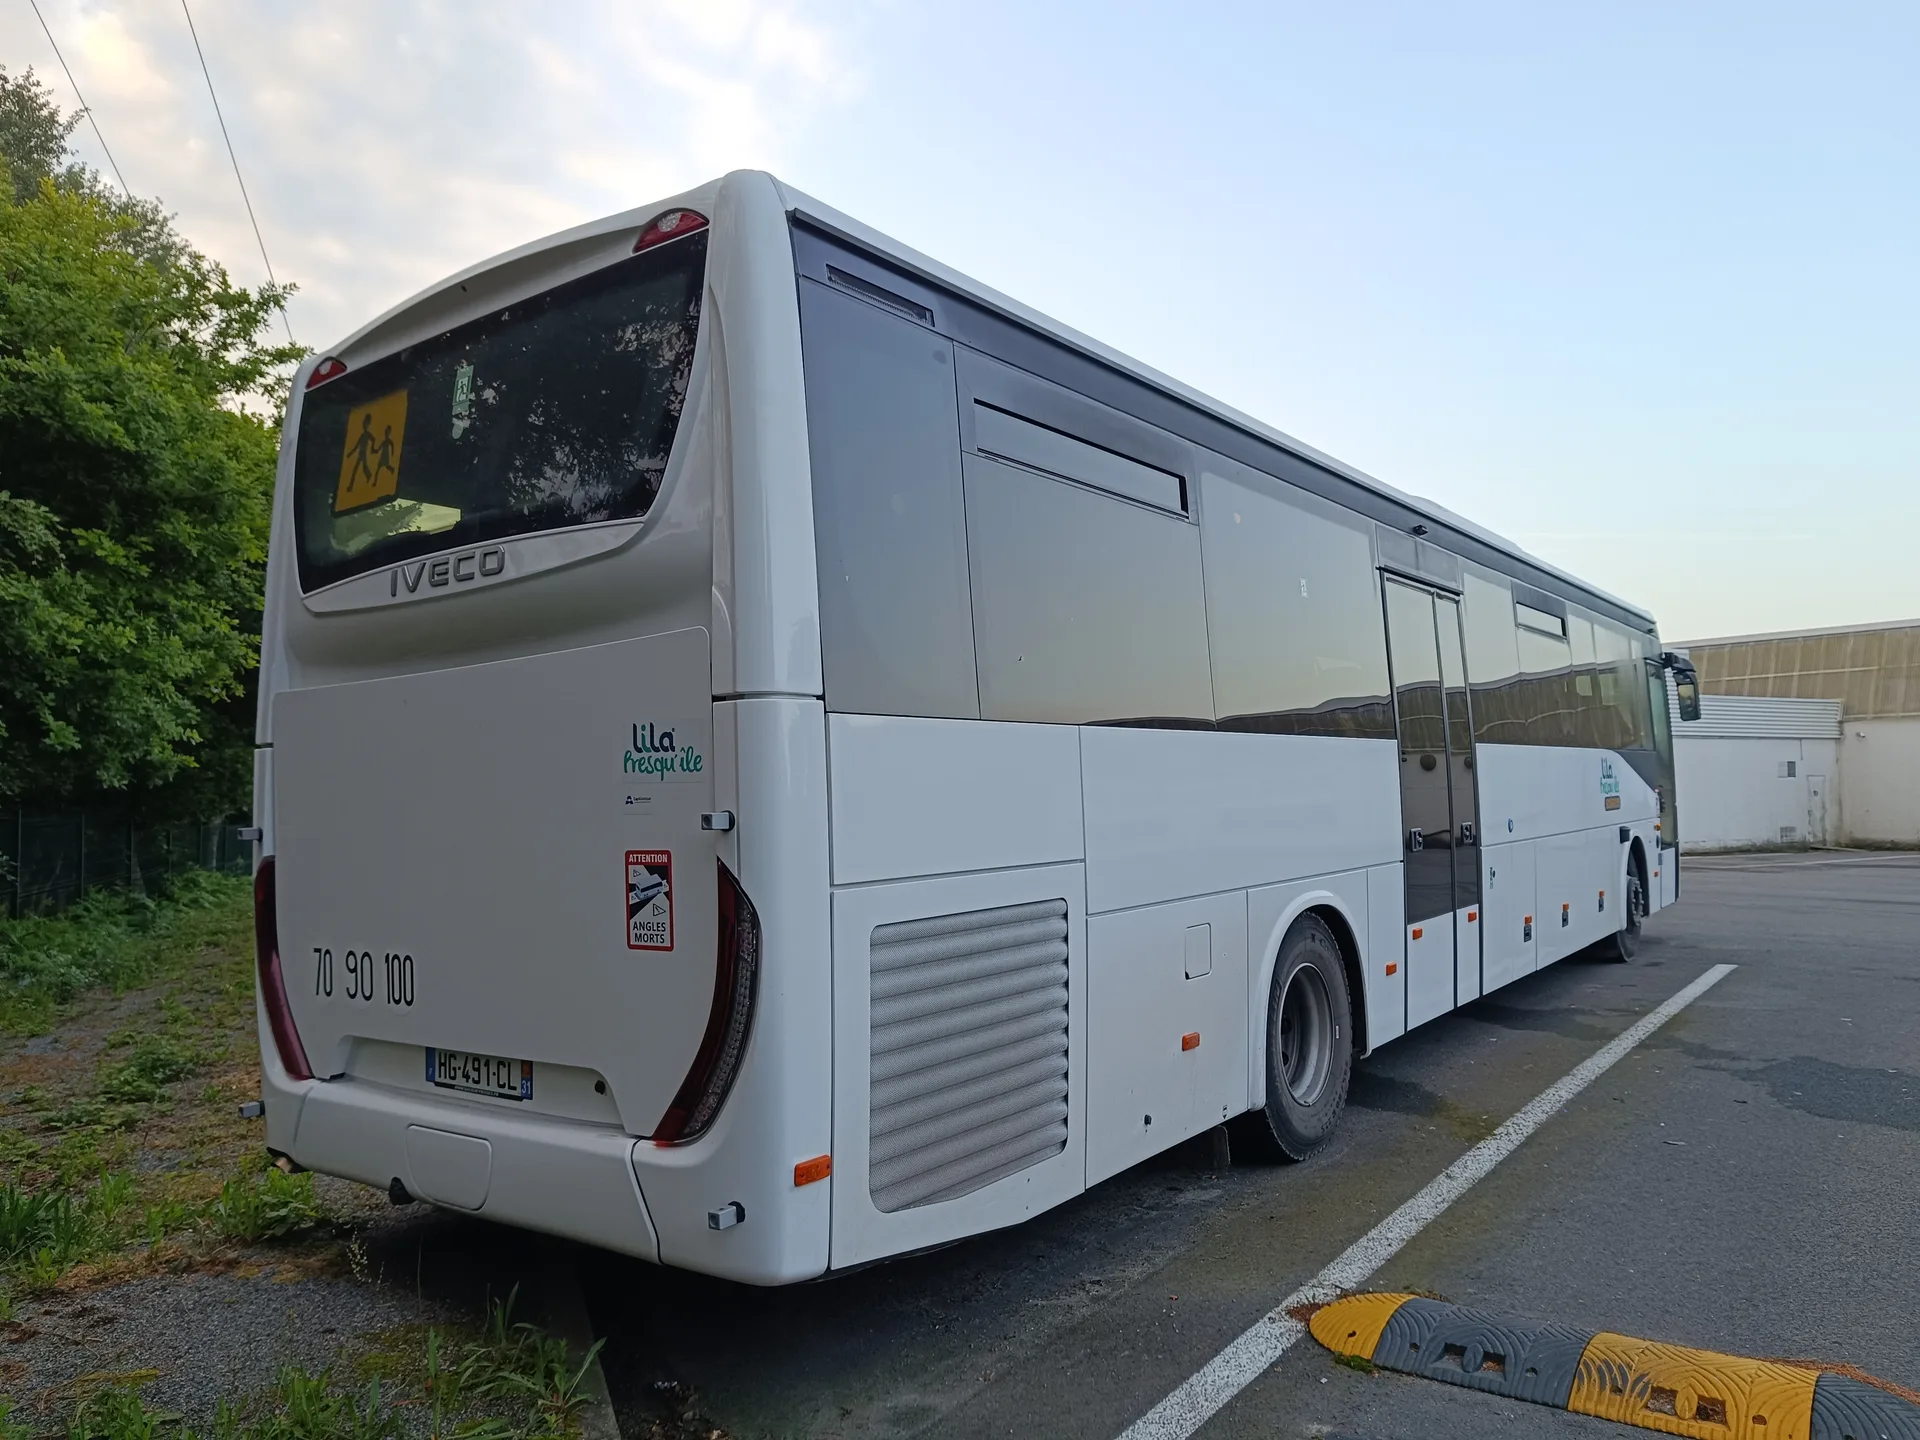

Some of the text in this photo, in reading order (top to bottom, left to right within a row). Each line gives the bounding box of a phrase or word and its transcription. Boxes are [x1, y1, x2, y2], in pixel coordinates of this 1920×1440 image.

[390, 545, 505, 597] IVECO
[628, 854, 668, 863] ATTENTION
[632, 921, 666, 932] ANGLES
[634, 932, 665, 944] MORTS
[313, 947, 415, 1006] 70 90 100
[438, 1052, 518, 1091] HG-491-CL
[521, 1079, 531, 1095] 31
